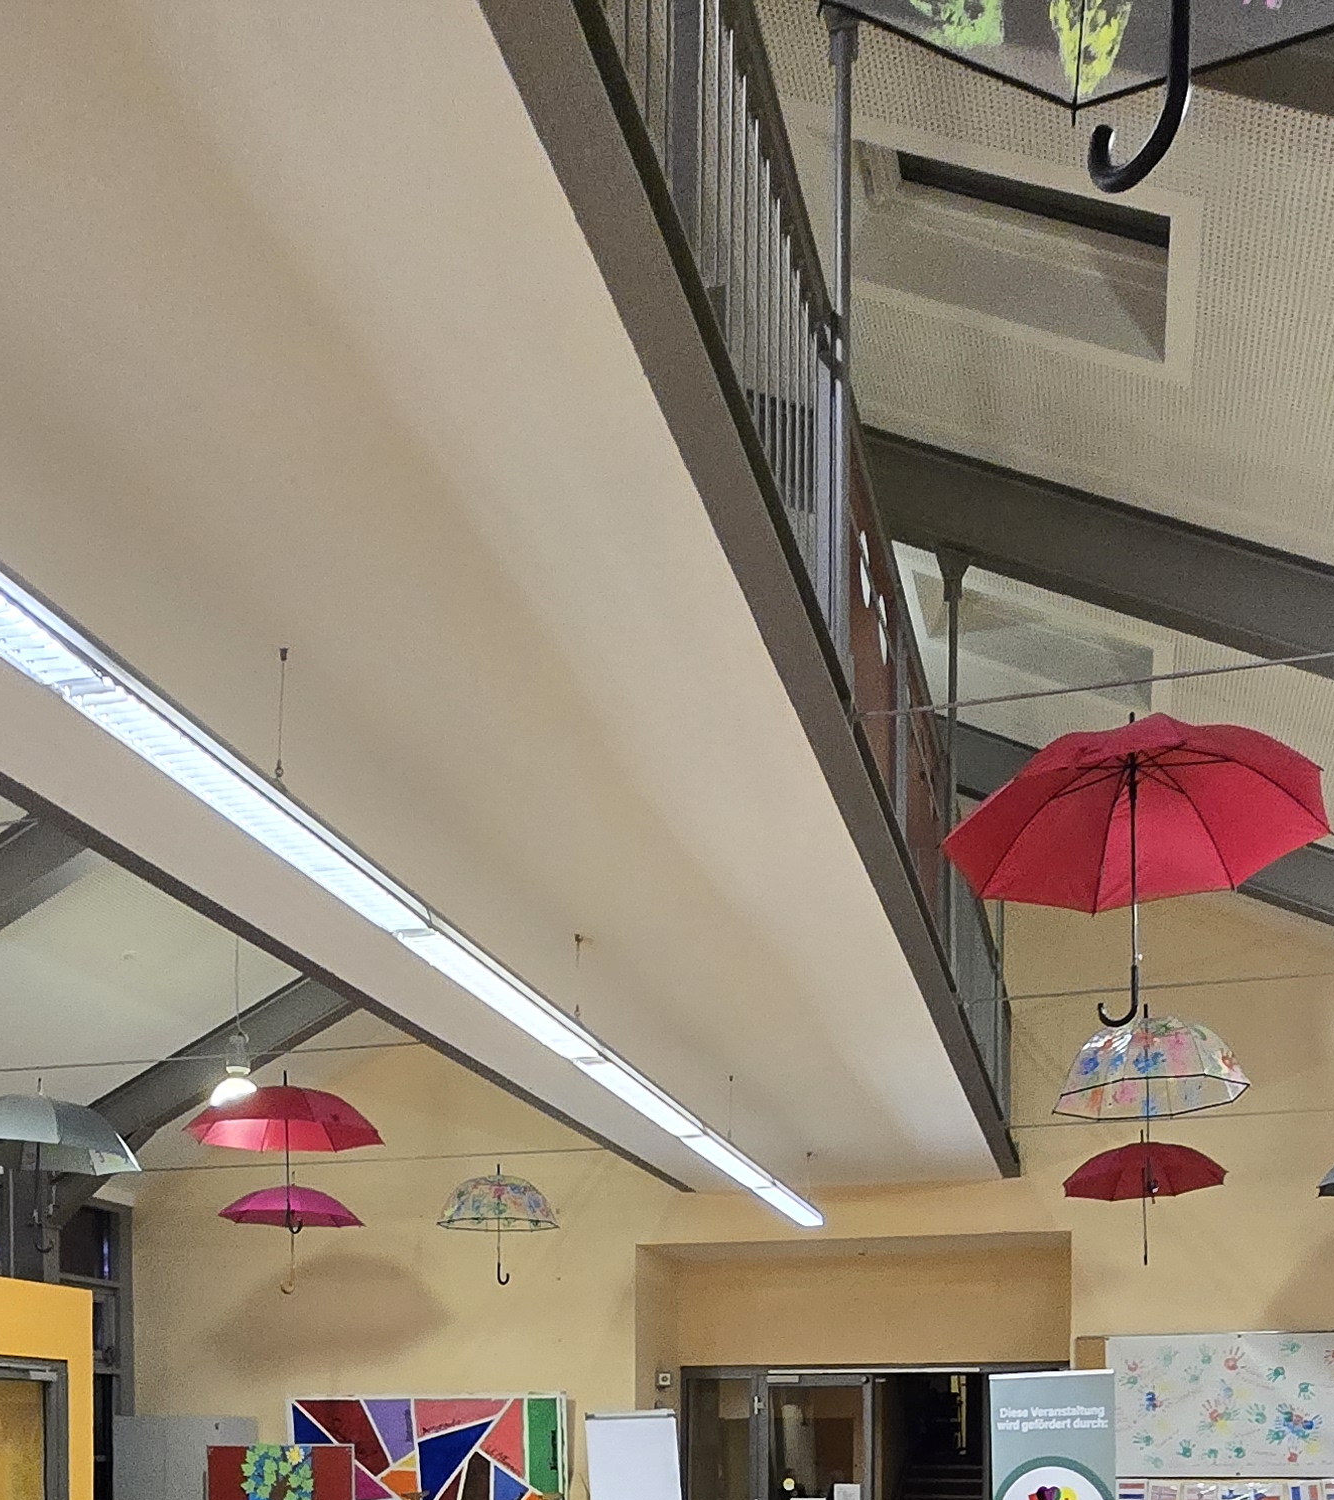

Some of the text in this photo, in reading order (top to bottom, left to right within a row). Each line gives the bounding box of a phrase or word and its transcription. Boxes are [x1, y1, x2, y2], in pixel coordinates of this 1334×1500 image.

[999, 1405, 1105, 1418] Diese Veranstaltung
[996, 1419, 1020, 1431] wird
[1021, 1418, 1071, 1432] gefördert
